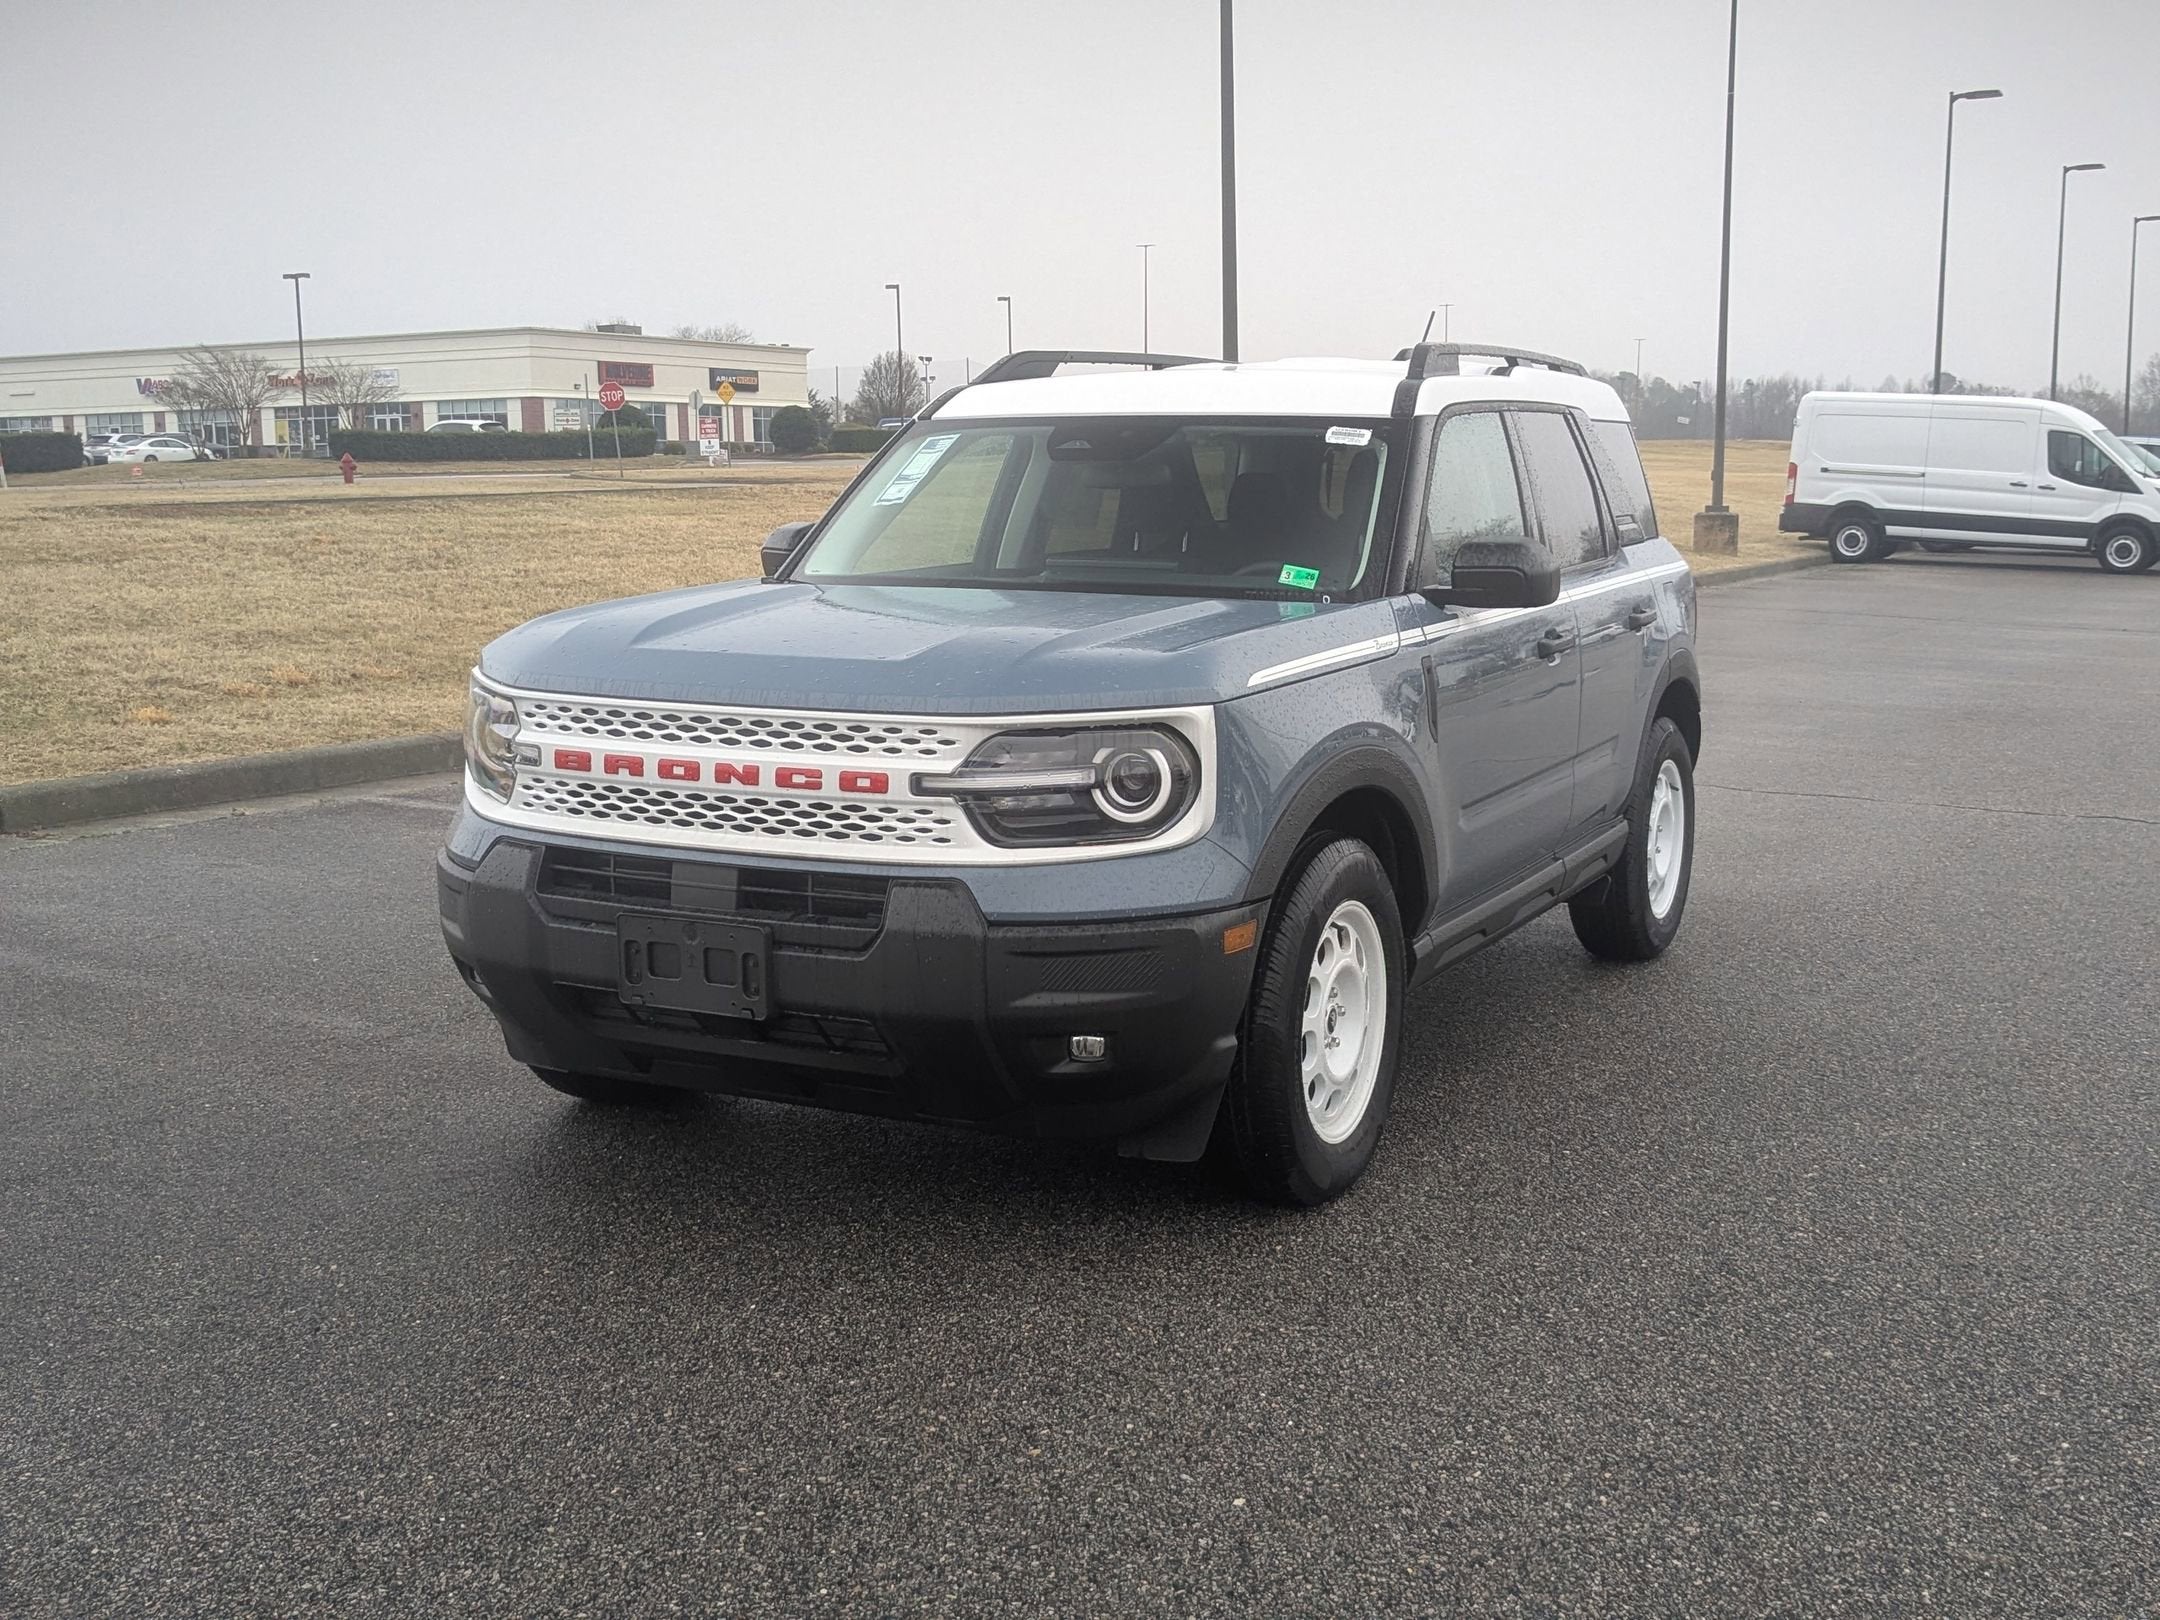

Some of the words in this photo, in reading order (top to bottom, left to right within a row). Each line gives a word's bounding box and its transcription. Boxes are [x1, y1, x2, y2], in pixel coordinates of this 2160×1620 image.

[600, 390, 623, 403] STOP
[1284, 571, 1291, 580] 3
[1304, 572, 1316, 581] 26
[554, 748, 889, 795] BRONCO
